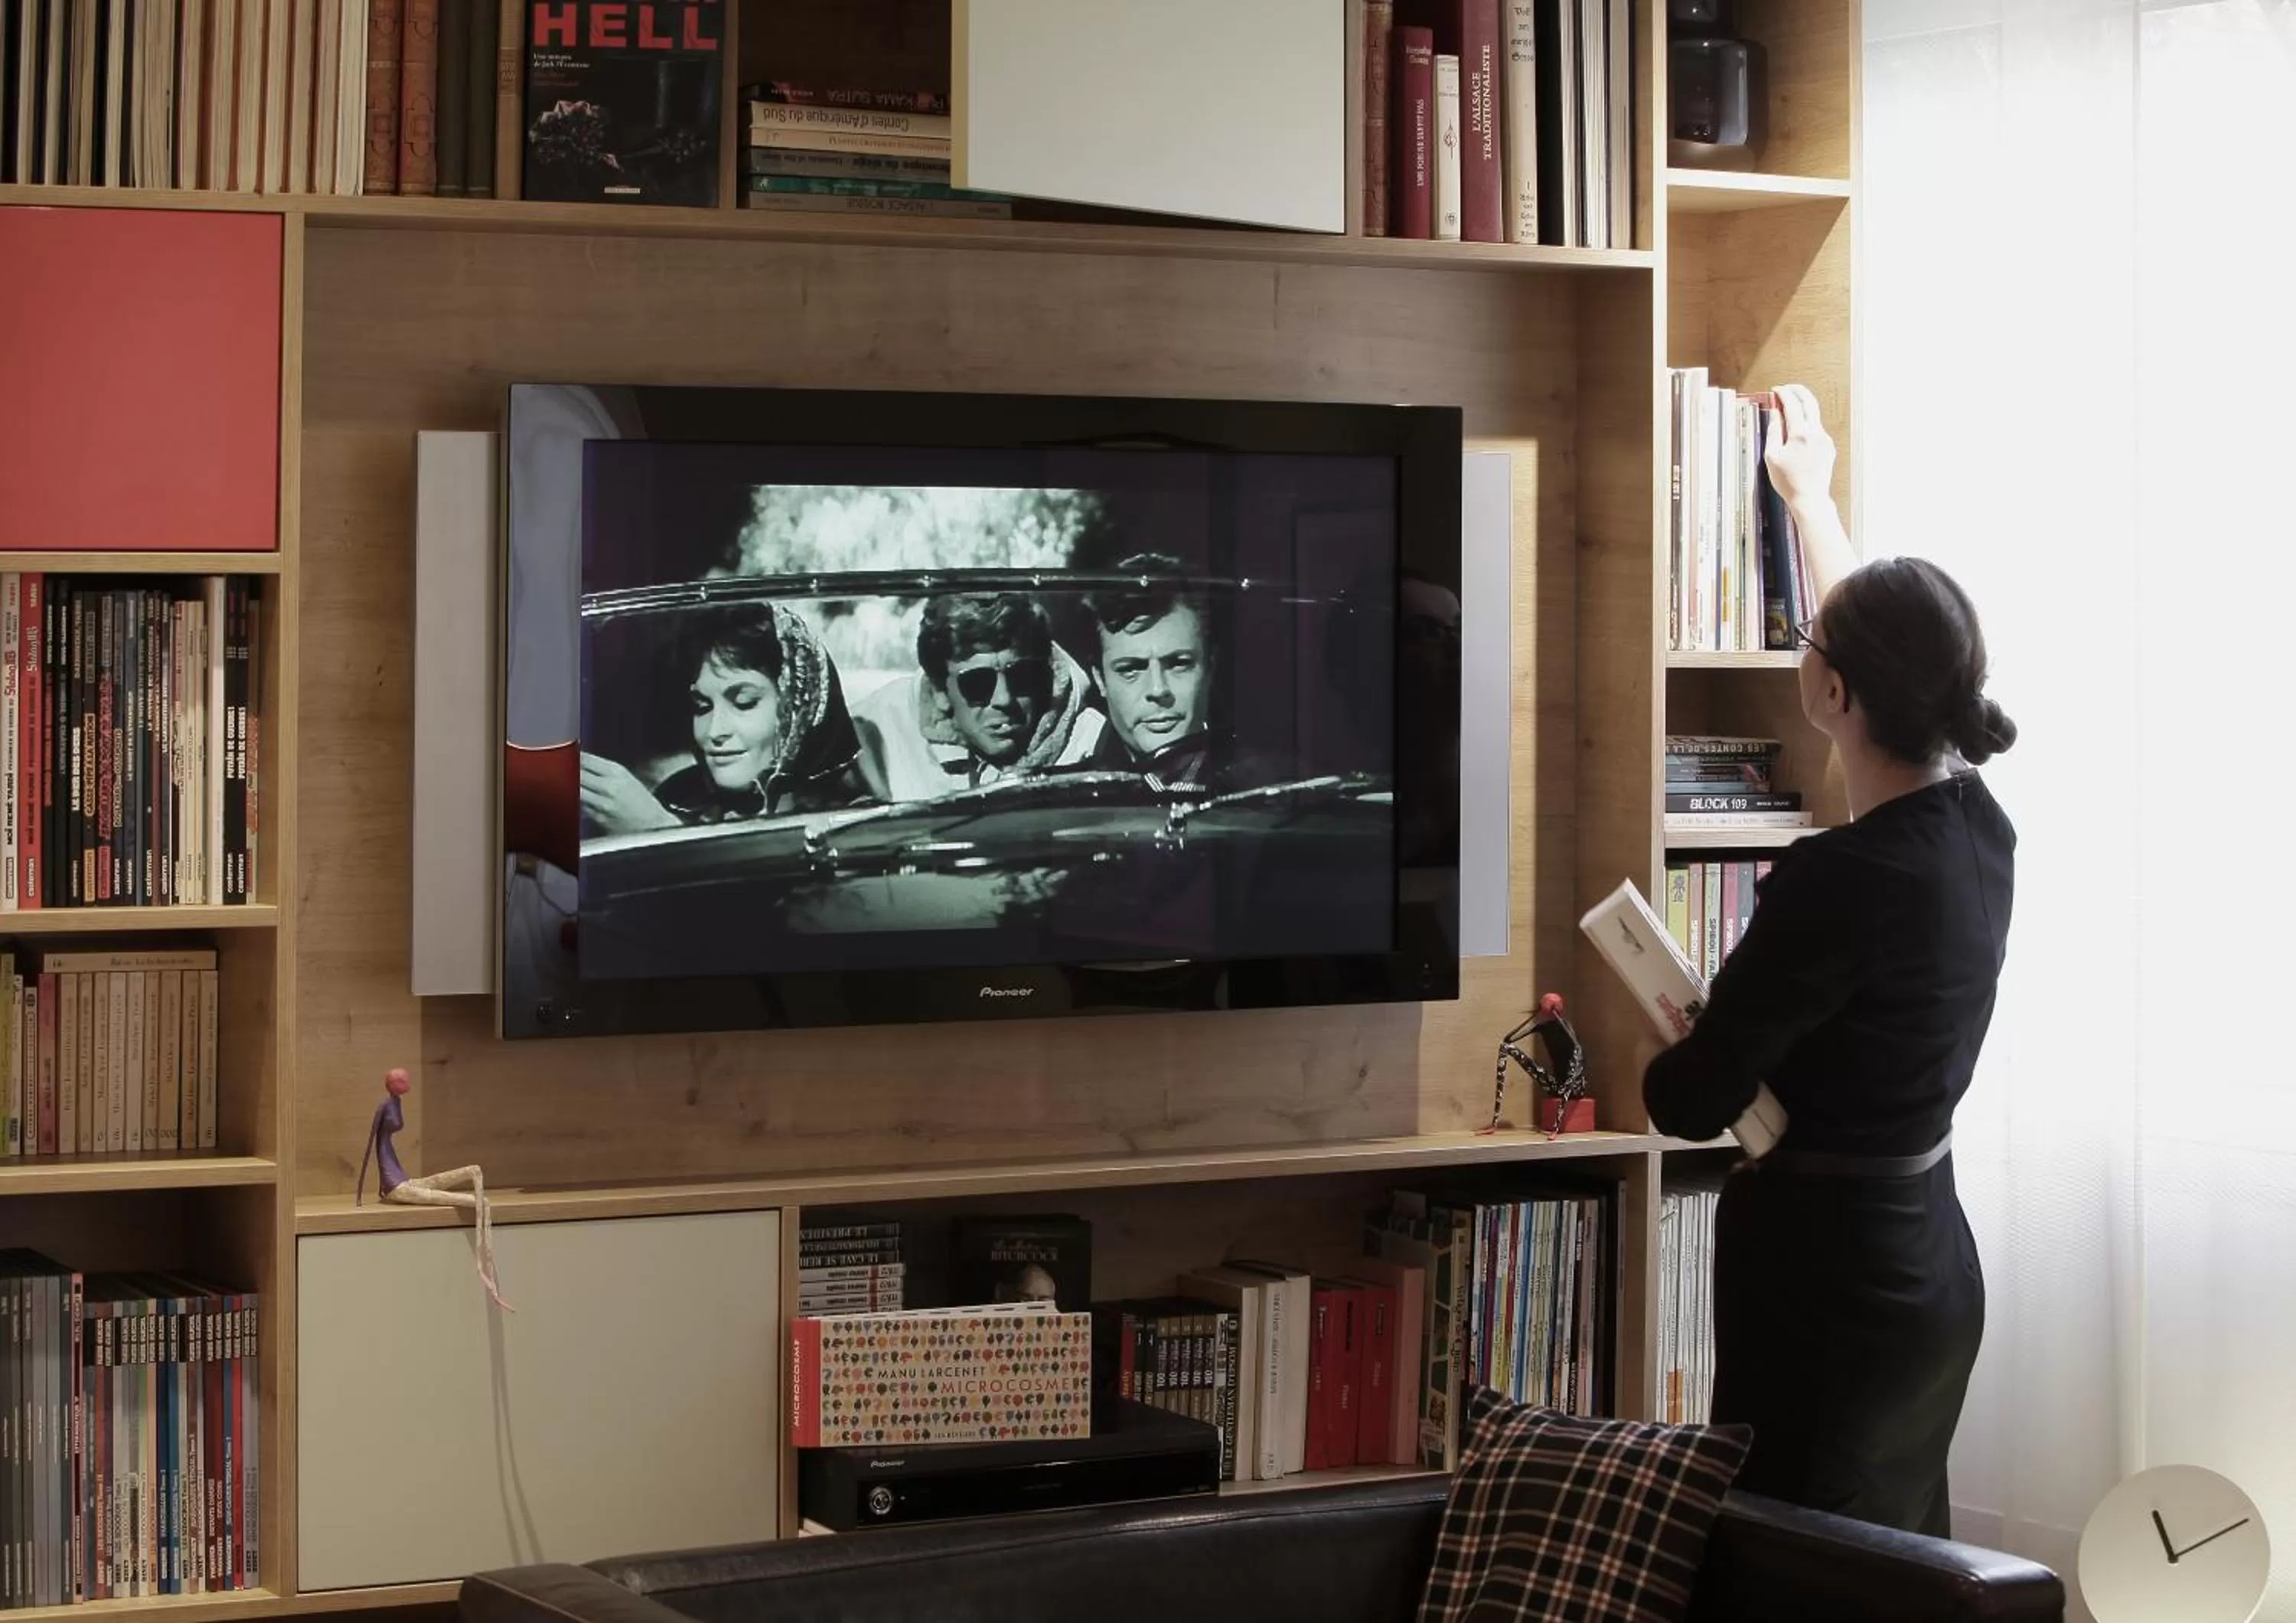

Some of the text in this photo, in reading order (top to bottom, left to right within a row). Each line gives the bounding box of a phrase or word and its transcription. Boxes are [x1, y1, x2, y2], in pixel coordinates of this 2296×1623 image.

[533, 2, 718, 51] HELL
[1471, 72, 1481, 132] L'ALSACE
[1482, 44, 1492, 160] TRADITIONALISTE
[762, 108, 909, 132] Contes d'Amérique du Sud
[86, 715, 94, 747] NATION
[1704, 743, 1743, 753] CONTES
[1747, 744, 1766, 753] LES
[1689, 797, 1729, 809] BLOCK
[1731, 798, 1747, 809] 109
[979, 987, 1035, 998] Pioneer
[840, 1254, 865, 1265] CAVE
[878, 1365, 986, 1379] MANU LARCENET
[940, 1377, 1069, 1393] MICROCOSME
[1225, 1388, 1236, 1445] GENTLEMAN
[1225, 1448, 1233, 1459] LE
